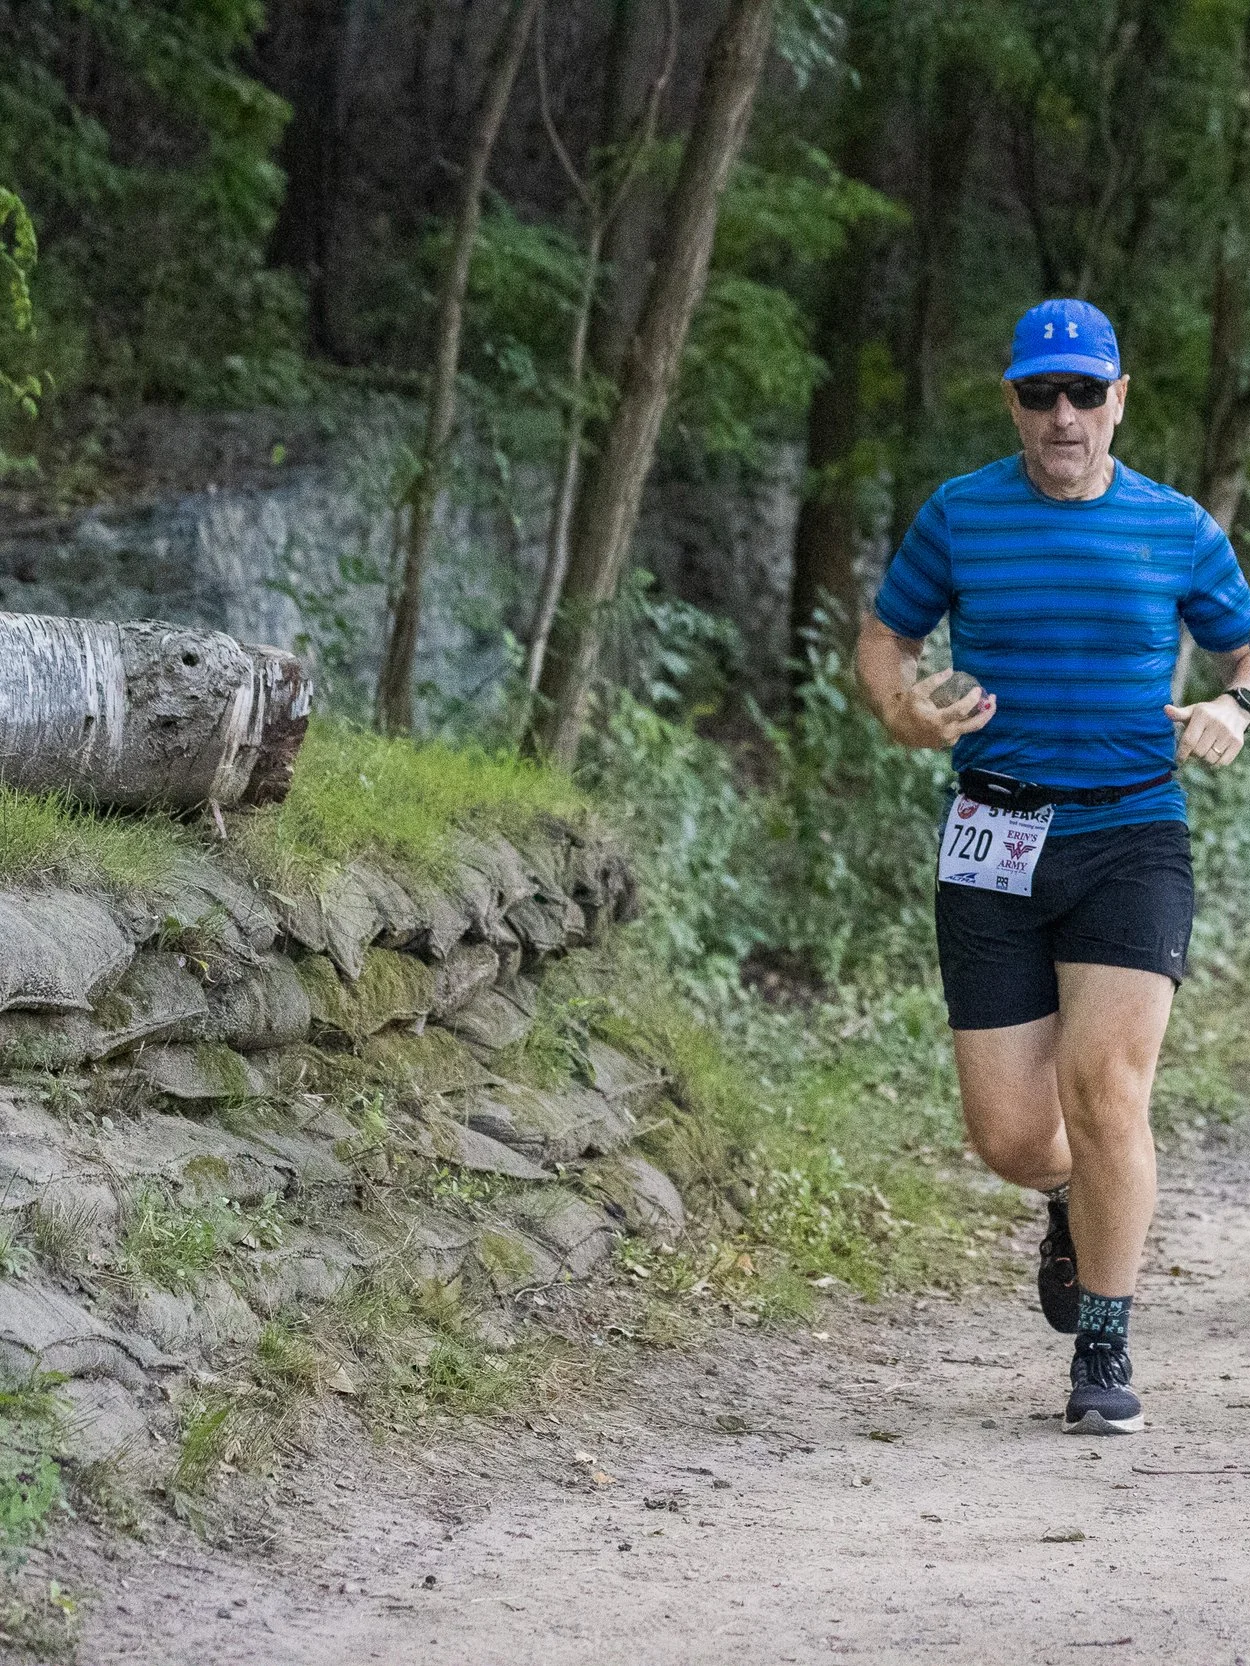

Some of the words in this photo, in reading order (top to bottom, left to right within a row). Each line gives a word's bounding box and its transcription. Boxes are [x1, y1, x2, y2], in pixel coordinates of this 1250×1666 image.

[988, 806, 999, 818] 5
[1007, 830, 1038, 842] ERIN'S
[947, 824, 993, 862] 720
[998, 859, 1028, 871] ARMY
